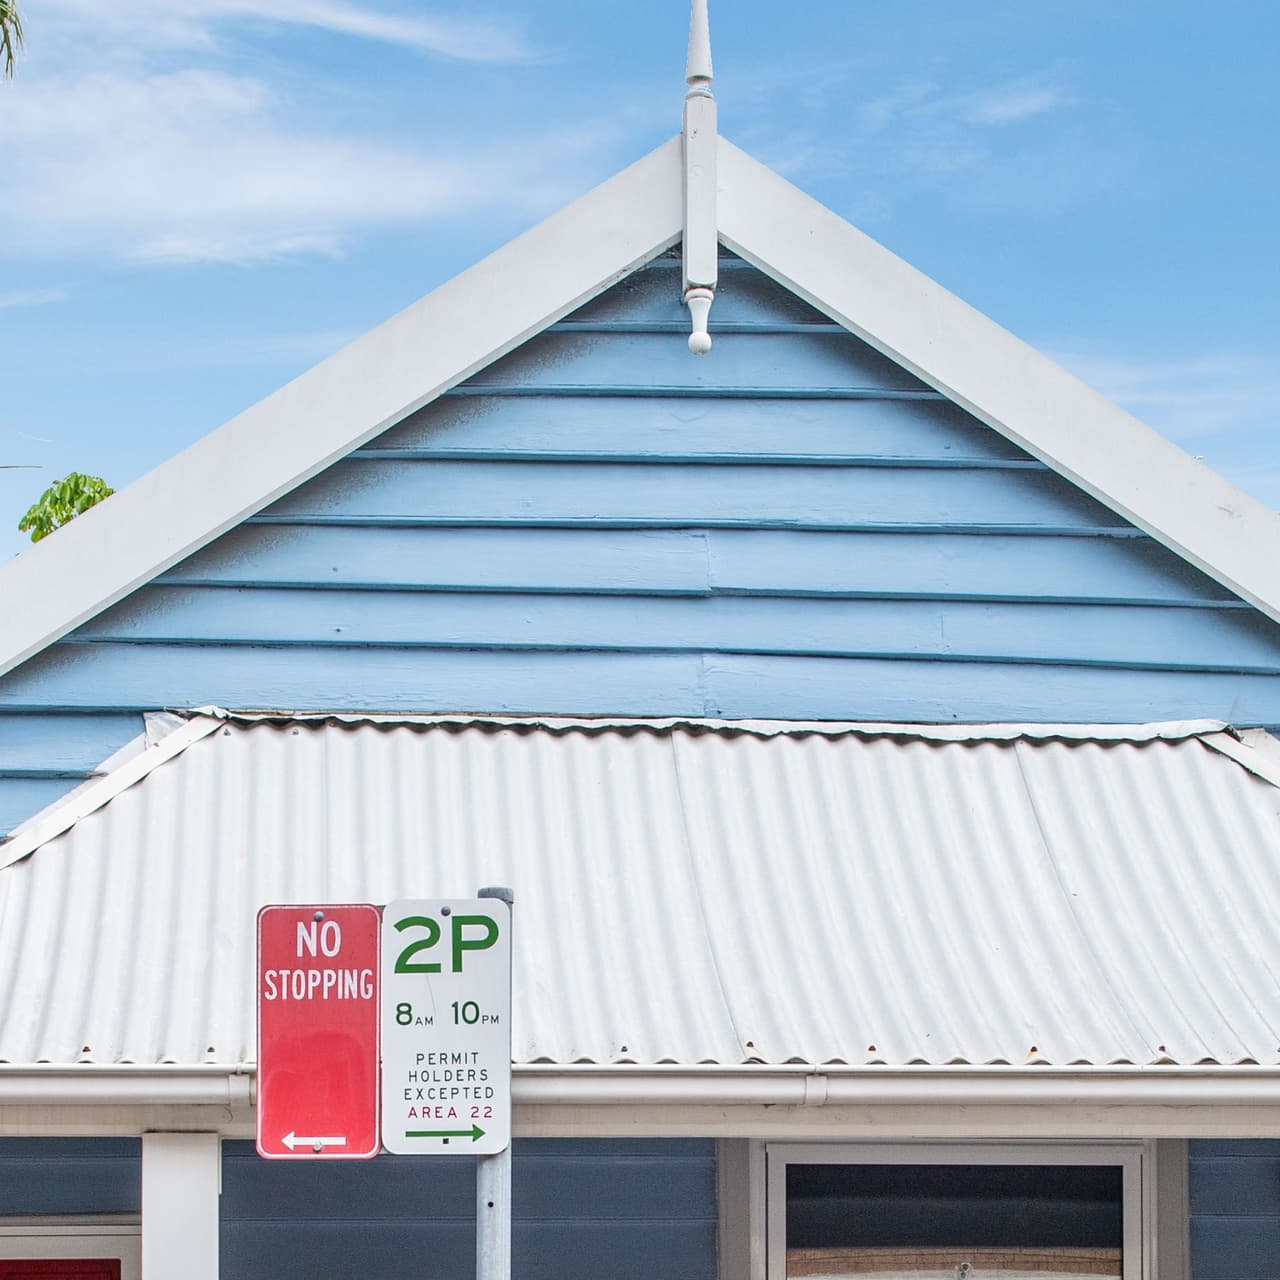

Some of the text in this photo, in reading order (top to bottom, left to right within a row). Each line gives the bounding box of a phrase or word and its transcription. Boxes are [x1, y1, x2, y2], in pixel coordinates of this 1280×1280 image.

[297, 921, 341, 957] NO
[393, 914, 500, 974] 2P
[264, 968, 373, 1000] STOPPING
[416, 1052, 479, 1066] PERMIT
[409, 1069, 488, 1083] HOLDERS
[404, 1086, 494, 1101] EXCEPTED
[408, 1106, 493, 1119] AREA 22
